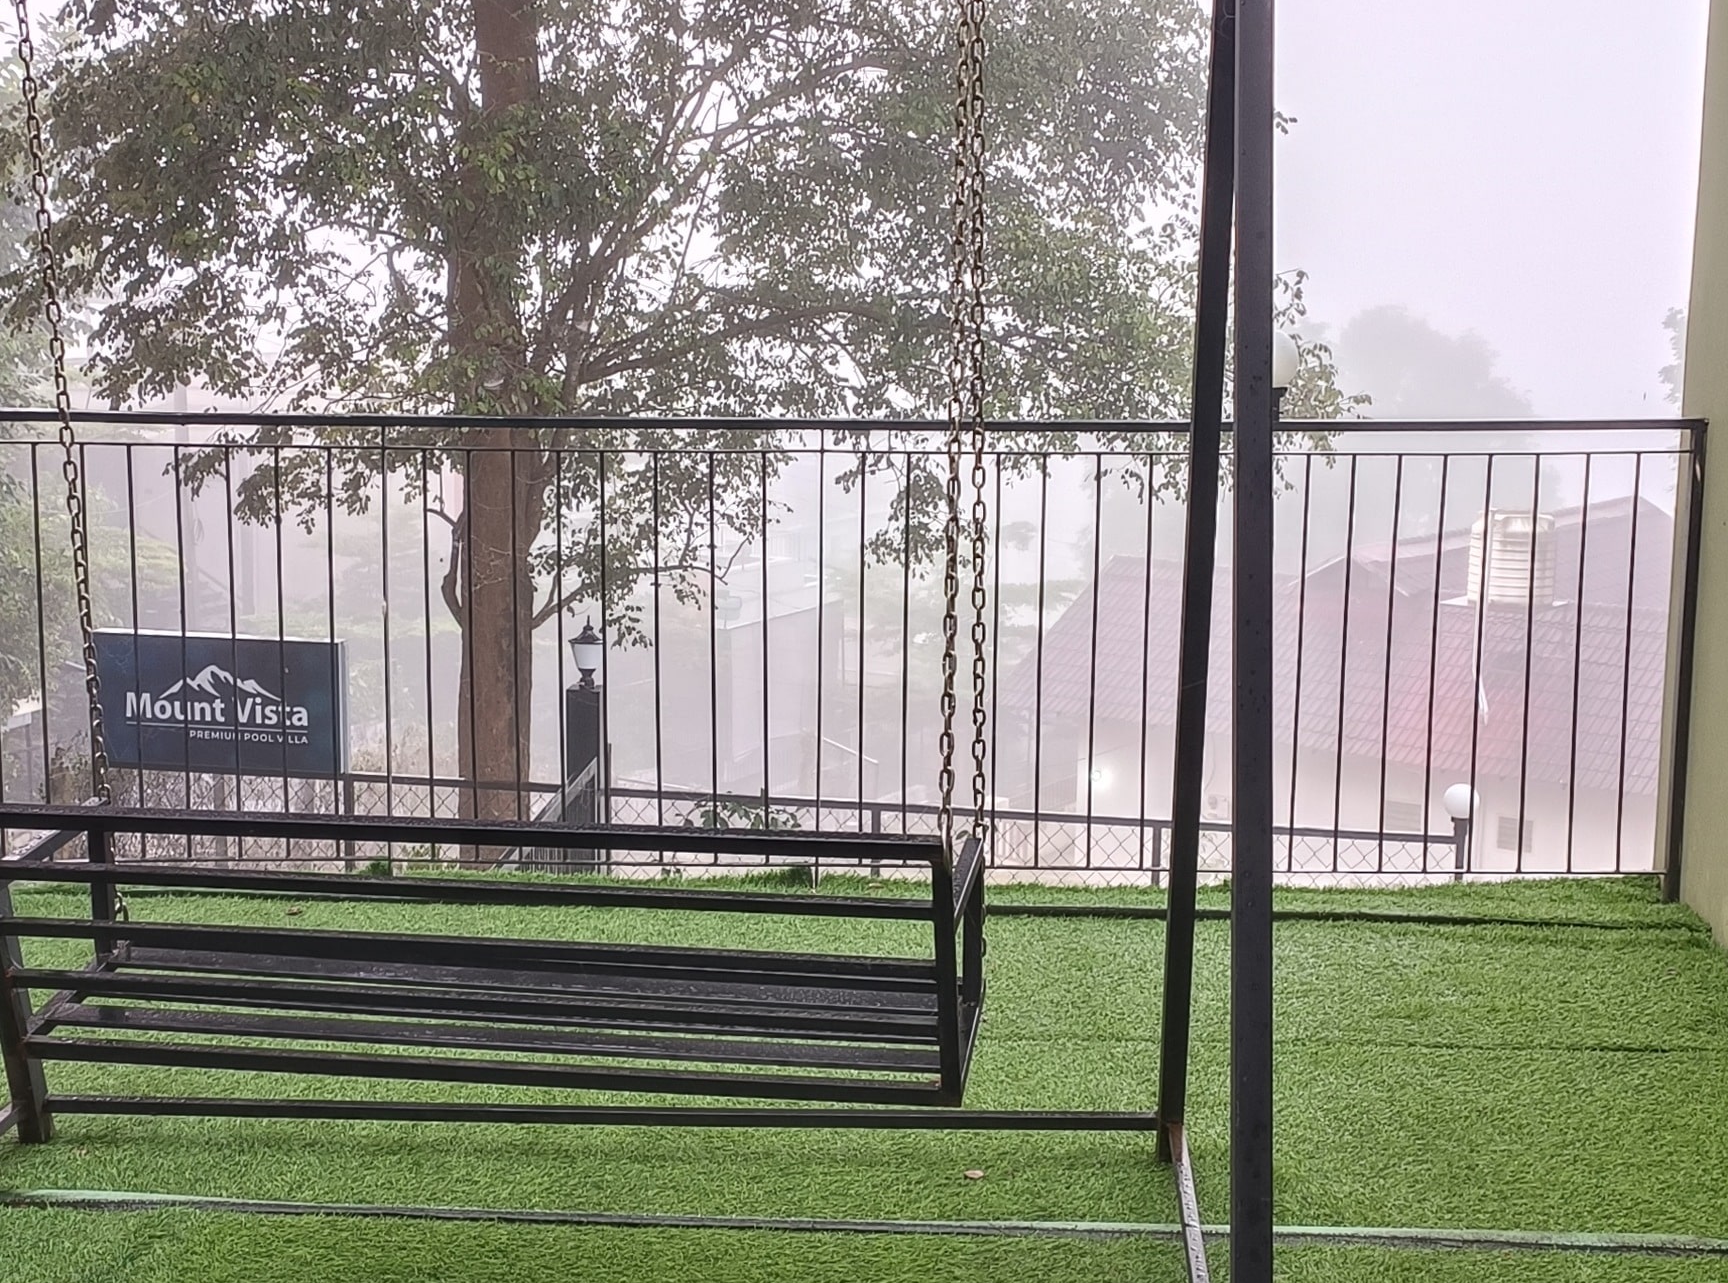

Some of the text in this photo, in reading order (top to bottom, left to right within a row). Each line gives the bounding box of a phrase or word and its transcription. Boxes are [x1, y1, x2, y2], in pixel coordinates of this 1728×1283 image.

[125, 691, 309, 727] Mount Vista
[244, 732, 275, 743] POOL
[276, 734, 309, 745] VLLA
